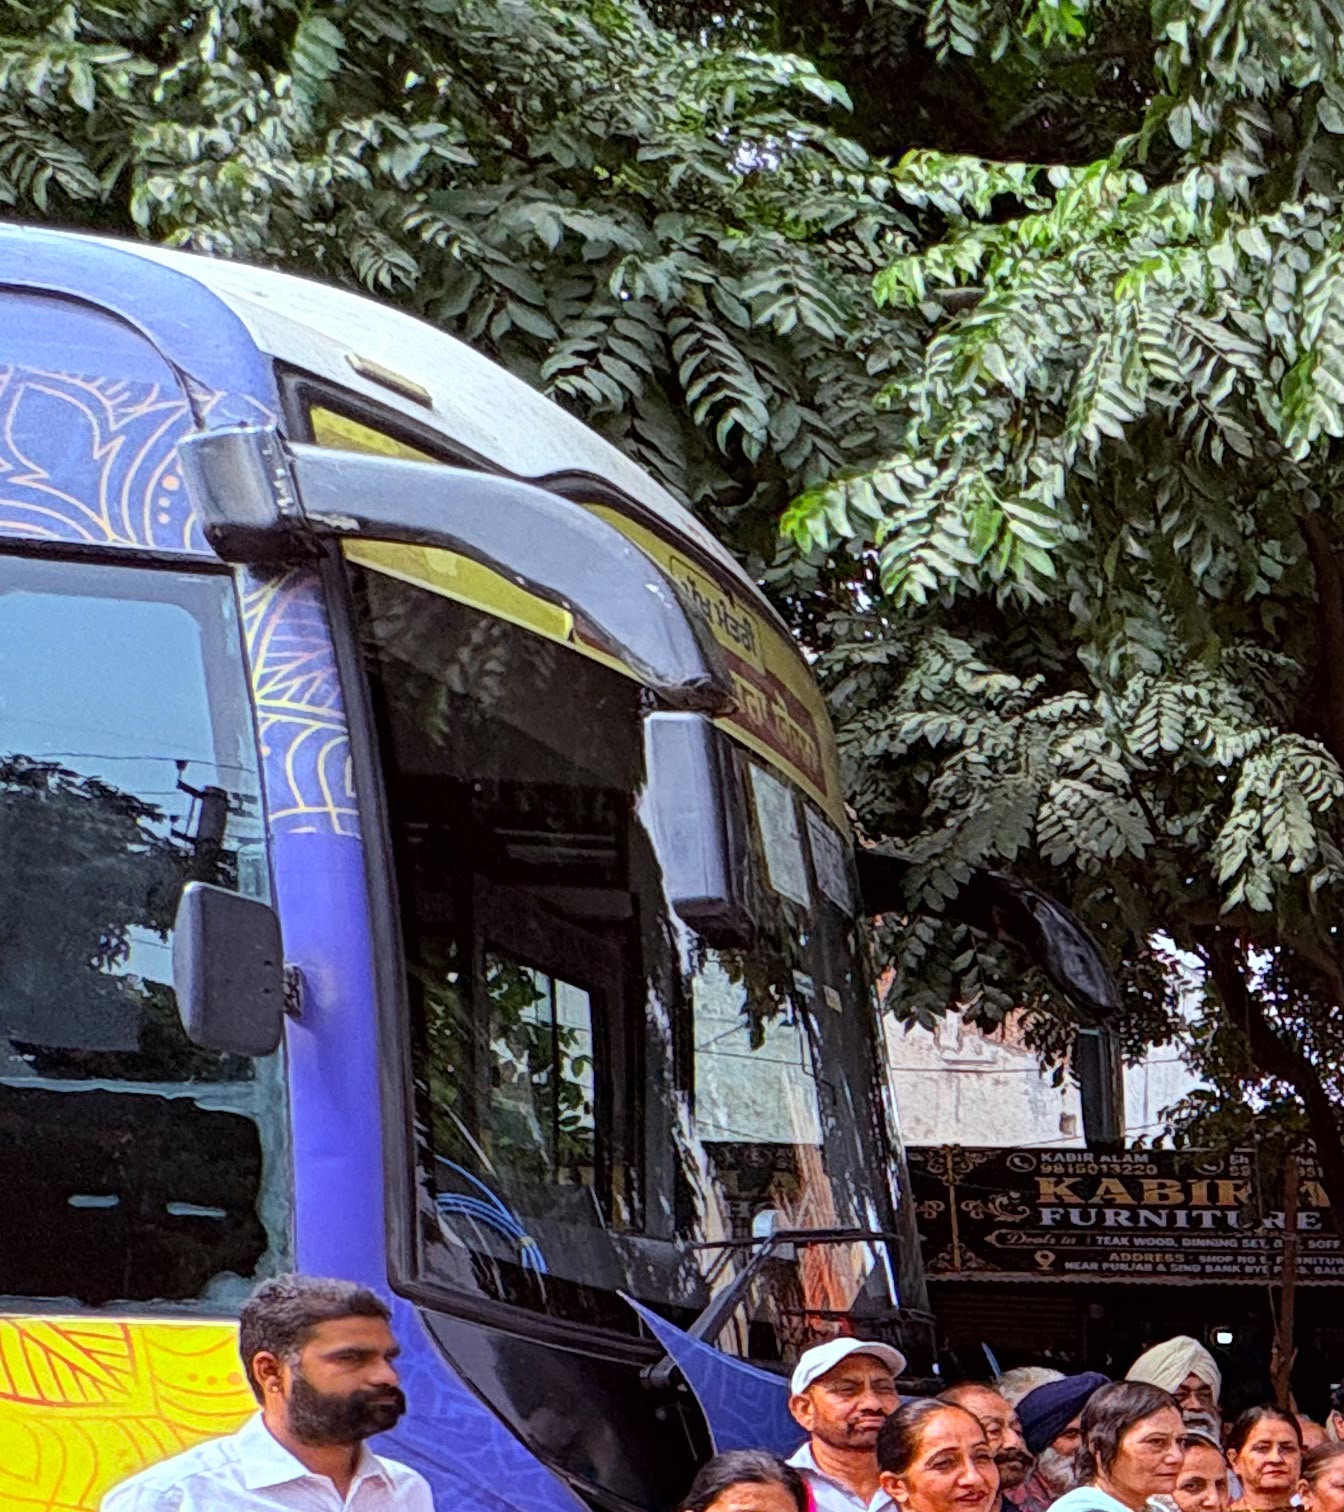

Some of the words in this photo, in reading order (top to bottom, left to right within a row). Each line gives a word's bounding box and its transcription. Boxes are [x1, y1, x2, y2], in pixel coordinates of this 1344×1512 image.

[1040, 1153, 1095, 1163] KABIR
[1099, 1153, 1149, 1164] ALAM
[1095, 1235, 1131, 1247] TEAK
[1108, 1252, 1185, 1263] ADDRESS
